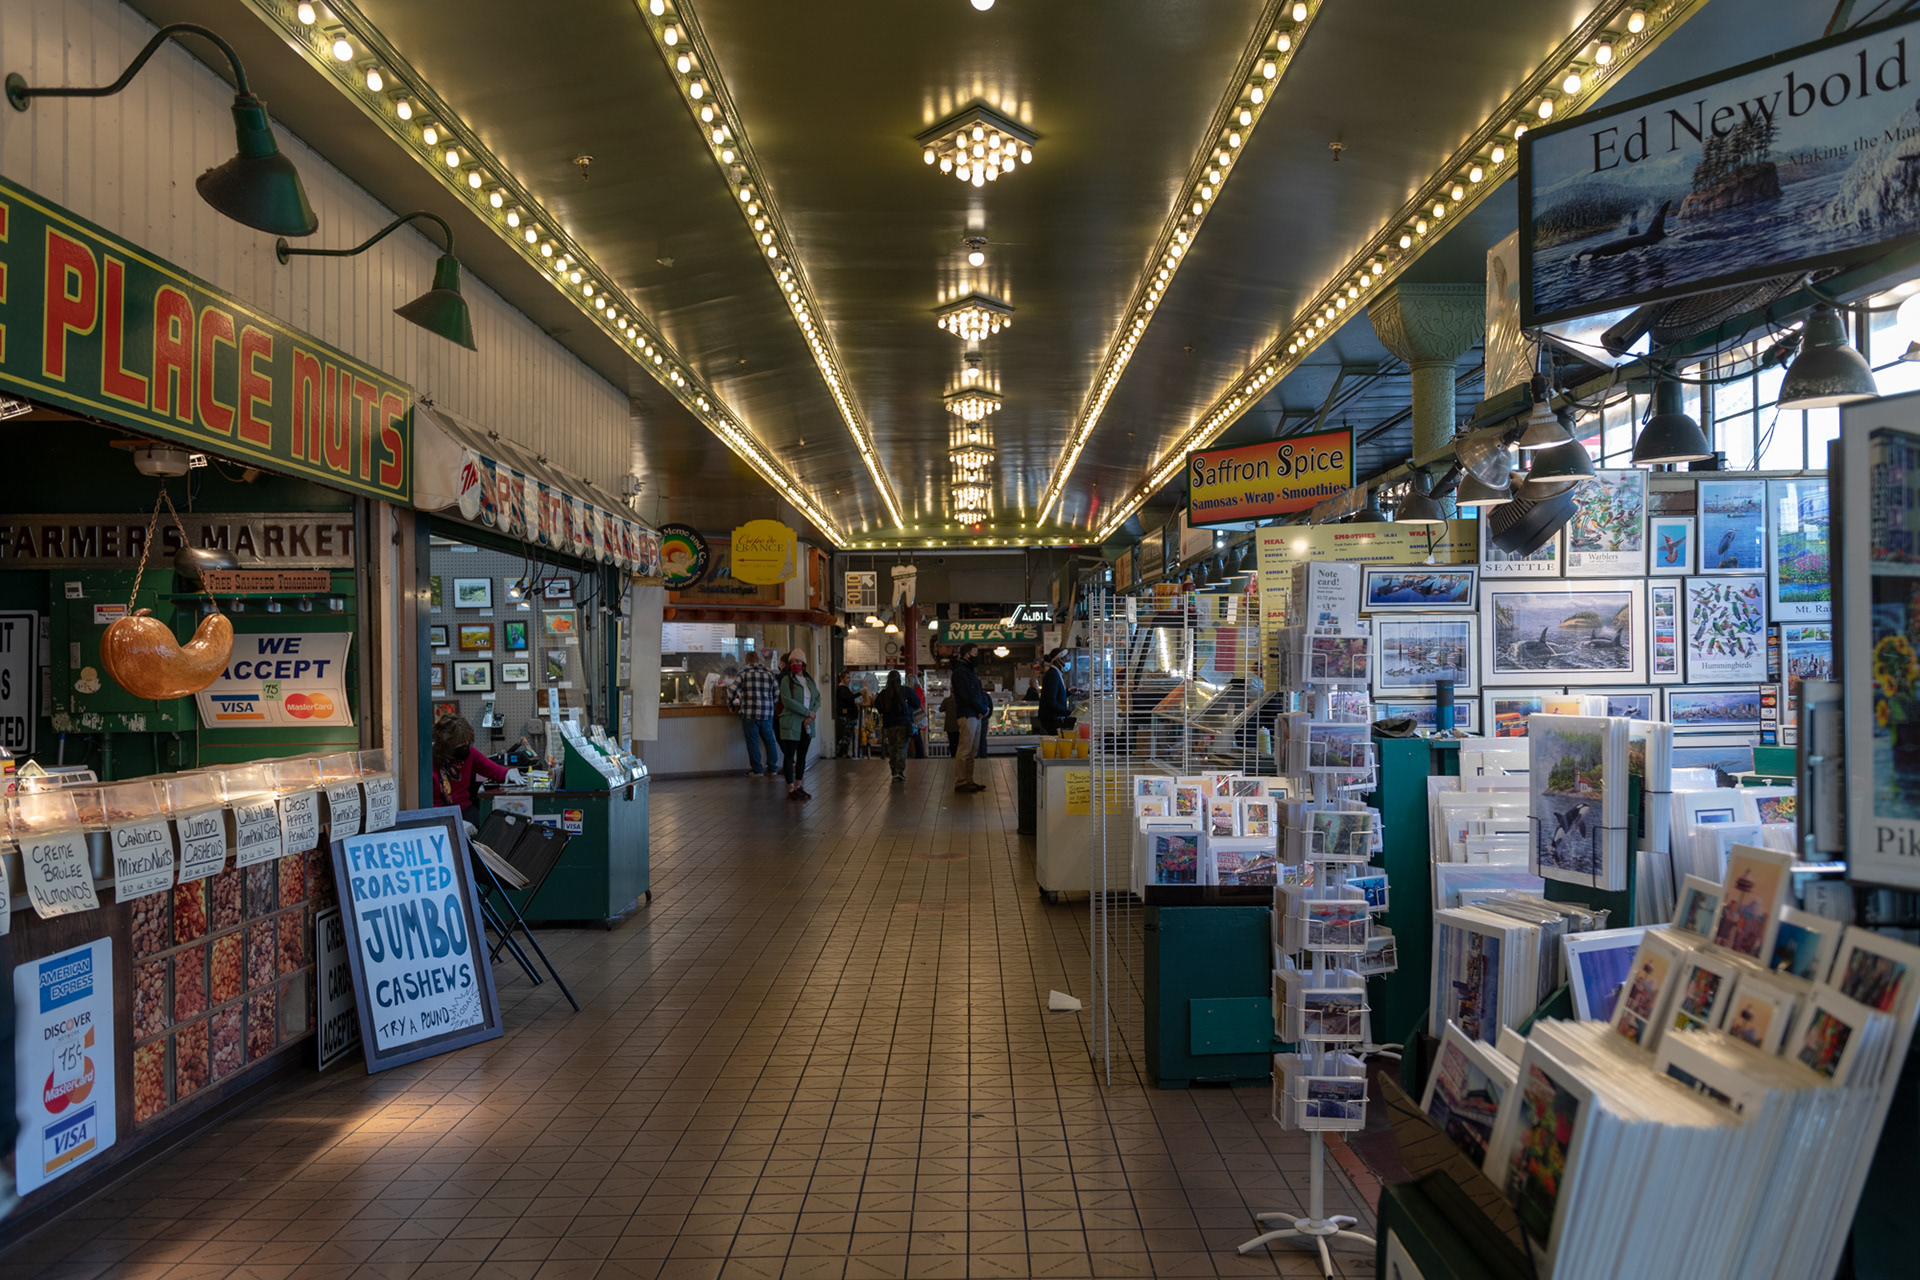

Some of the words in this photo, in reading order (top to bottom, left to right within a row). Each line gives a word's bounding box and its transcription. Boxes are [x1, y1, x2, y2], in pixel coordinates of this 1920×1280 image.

[1589, 115, 1651, 175] Ed
[1665, 37, 1910, 154] Newbold
[1790, 145, 1848, 167] Making
[1854, 136, 1878, 152] the
[42, 225, 274, 450] PLACE
[291, 347, 404, 489] NUTS
[1192, 457, 1270, 488] Saffron
[1277, 443, 1345, 480] Spice
[1192, 495, 1238, 511] Samosas
[1244, 491, 1275, 505] Wrap
[1282, 483, 1347, 500] Smoothies
[201, 524, 354, 557] MARKET
[690, 535, 705, 550] and
[736, 543, 784, 552] FRANCE
[1319, 569, 1338, 578] Note
[1485, 563, 1555, 572] SEATTLE
[209, 574, 232, 590] FREE
[235, 574, 275, 590] SAMPLES
[277, 573, 329, 590] TOMORROW
[847, 574, 861, 607] FOLIO
[1022, 612, 1043, 621] ALIBI
[1795, 605, 1811, 614] Mt.
[948, 630, 1038, 639] MEATS
[950, 622, 976, 631] Don
[978, 622, 1000, 631] and
[258, 638, 302, 655] WE
[1702, 661, 1752, 670] Hummingbirds
[220, 702, 254, 712] VISA
[287, 703, 333, 711] MasterCard
[284, 797, 310, 813] GHOST
[371, 796, 392, 808] MIXED
[286, 812, 312, 827] PEPPER
[373, 808, 390, 822] NUTS
[184, 817, 217, 839] JUMBO
[288, 827, 316, 842] PEANUTS
[32, 843, 75, 864] CREME
[184, 840, 224, 864] CASHEWS
[348, 834, 445, 872] FRESHLY
[41, 862, 83, 883] BRULEE
[34, 881, 92, 909] ALMONDS
[352, 866, 451, 902] ROASTED
[361, 893, 468, 963] JUMBO
[39, 957, 91, 987] AMERICAN
[50, 974, 94, 1000] EXPRESS
[376, 963, 471, 1008] CASHEWS
[44, 1011, 91, 1041] DISCOVER
[379, 1016, 406, 1039] TRY
[410, 1018, 418, 1033] A
[421, 1007, 449, 1030] POUND
[456, 995, 474, 1020] TODAY
[44, 1069, 94, 1103] MasterCard
[54, 1122, 87, 1155] VISA
